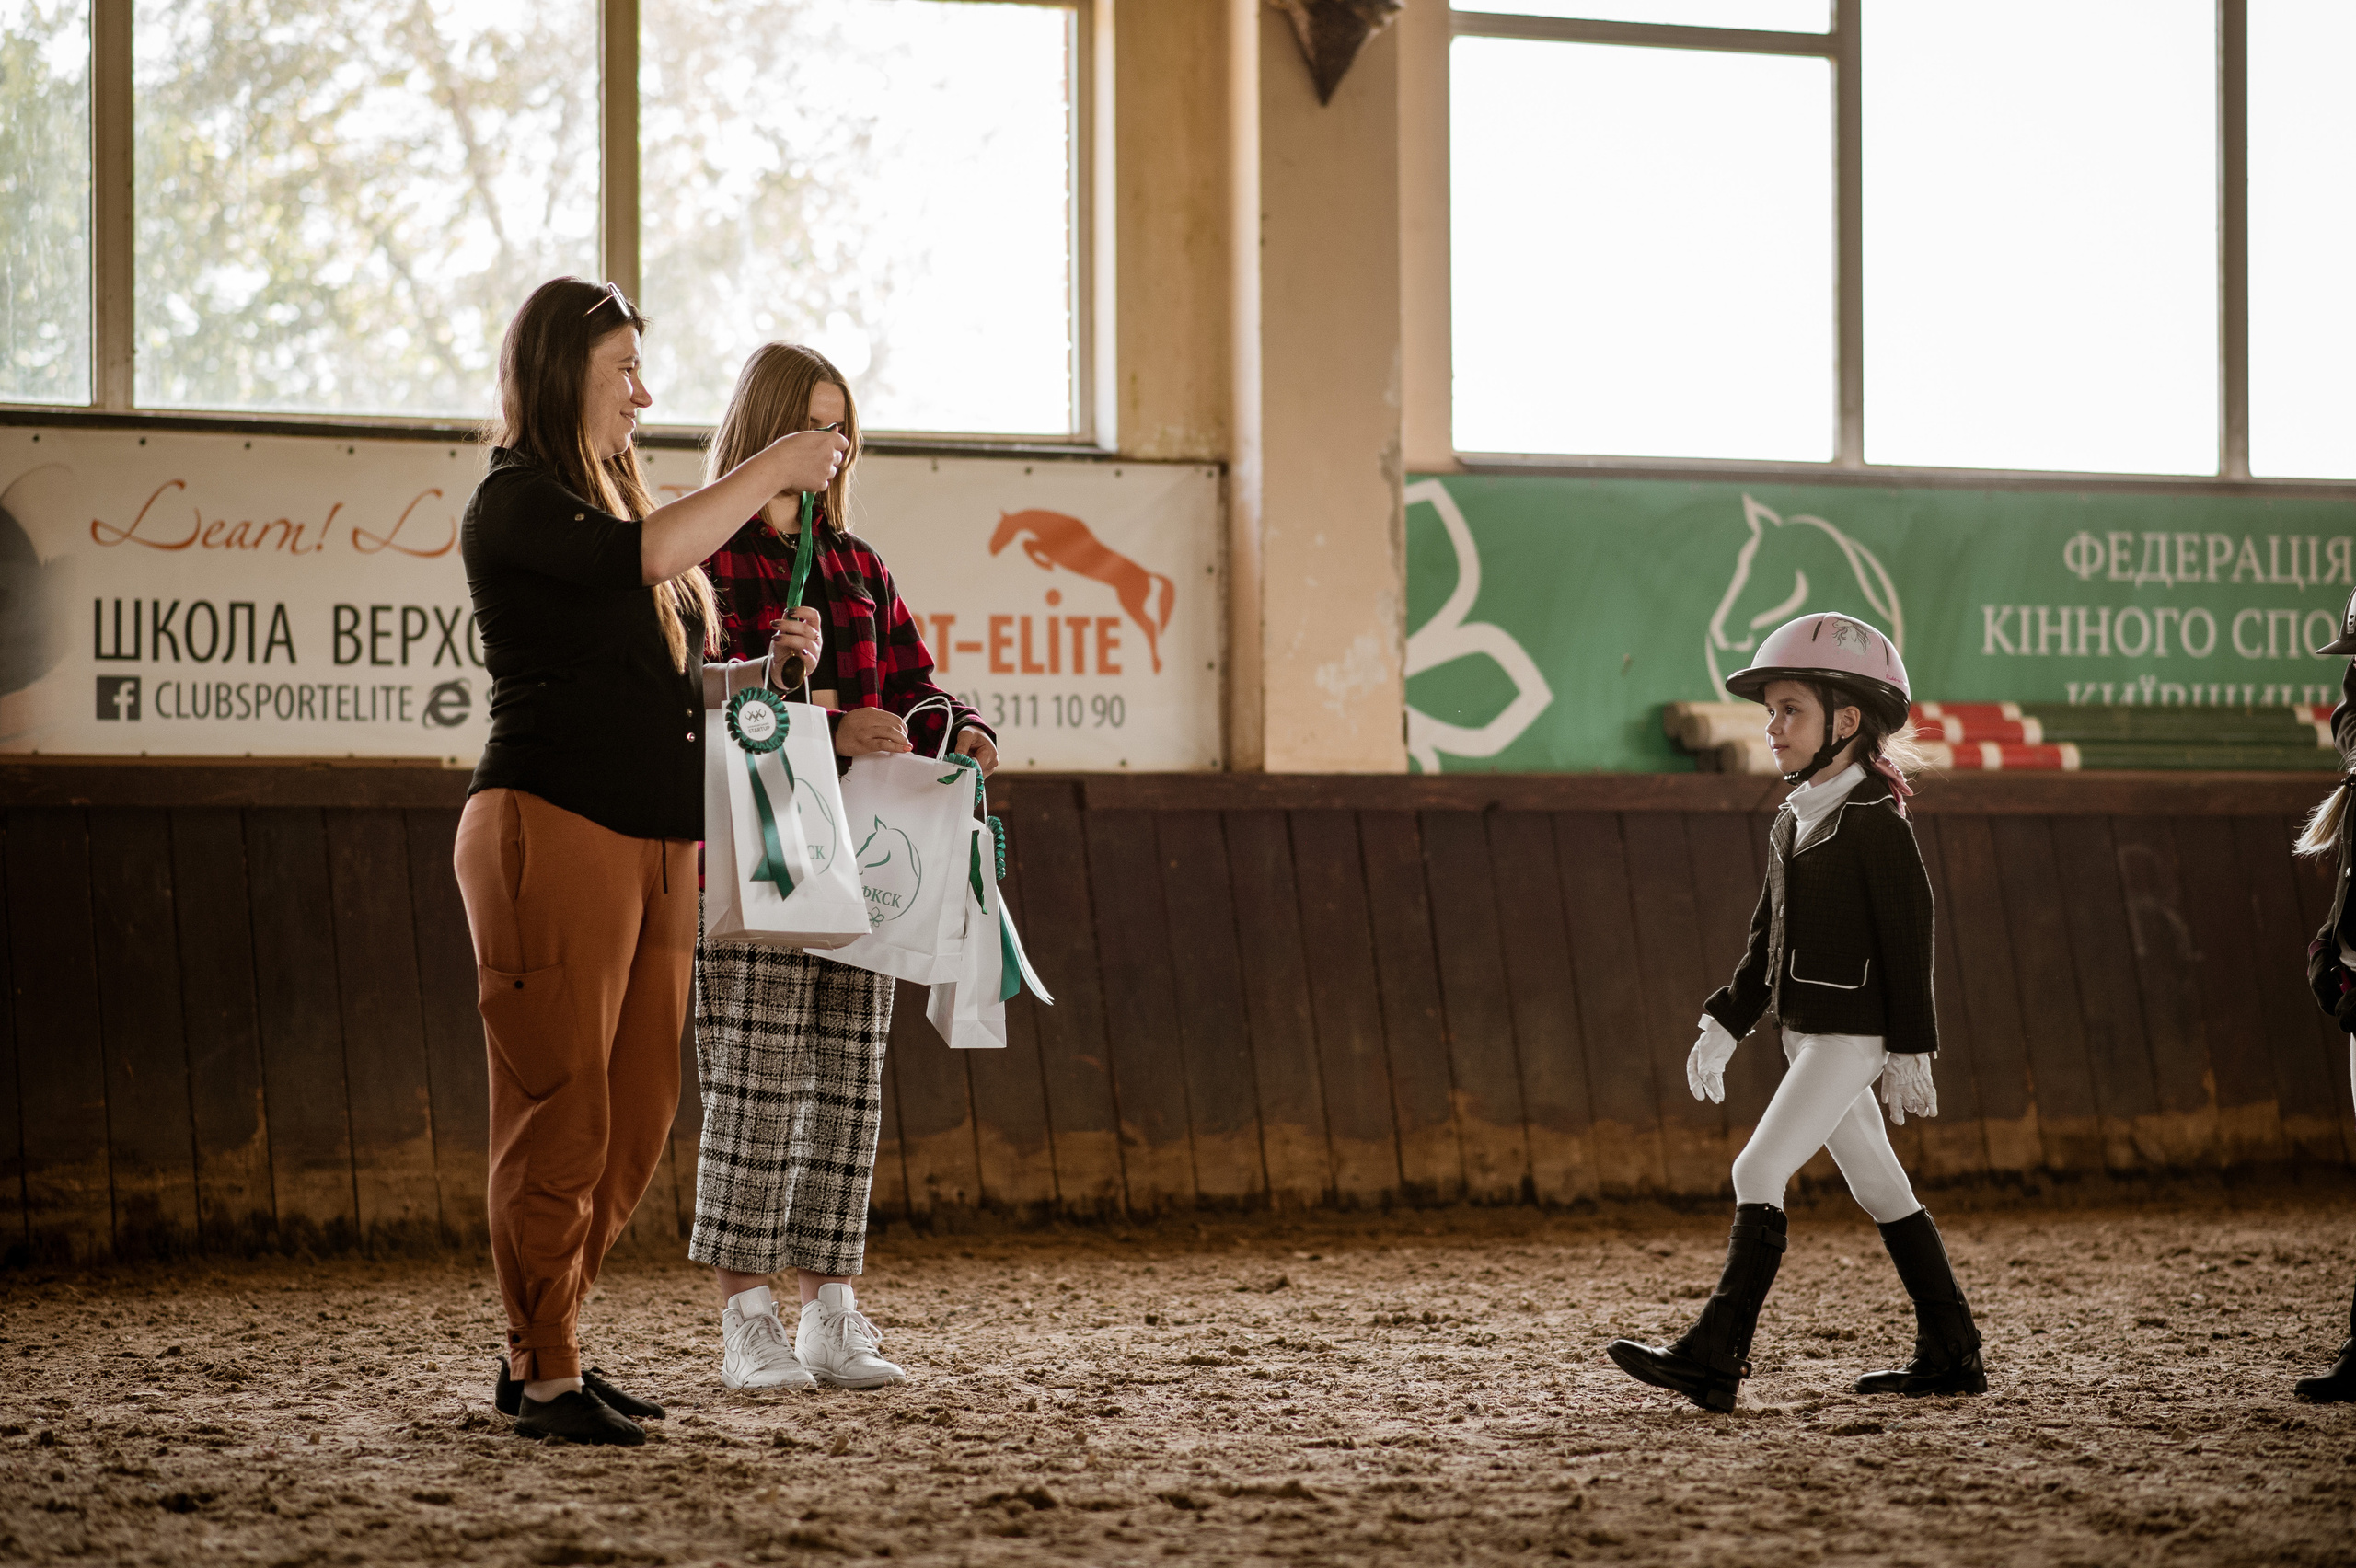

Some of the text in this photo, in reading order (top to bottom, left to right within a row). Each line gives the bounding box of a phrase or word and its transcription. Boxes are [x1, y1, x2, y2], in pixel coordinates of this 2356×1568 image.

[89, 478, 463, 559] Learn! L
[2062, 530, 2355, 593] ФЕДЕРАЦІЯ
[94, 597, 298, 665] ШКОЛА
[1981, 604, 2350, 661] КІННОГО СПО
[155, 680, 414, 723] CLUBSPORTELITE
[748, 726, 771, 734] STARTUP
[991, 692, 1038, 728] 311
[1052, 693, 1085, 729] 10
[1091, 693, 1126, 729] 90
